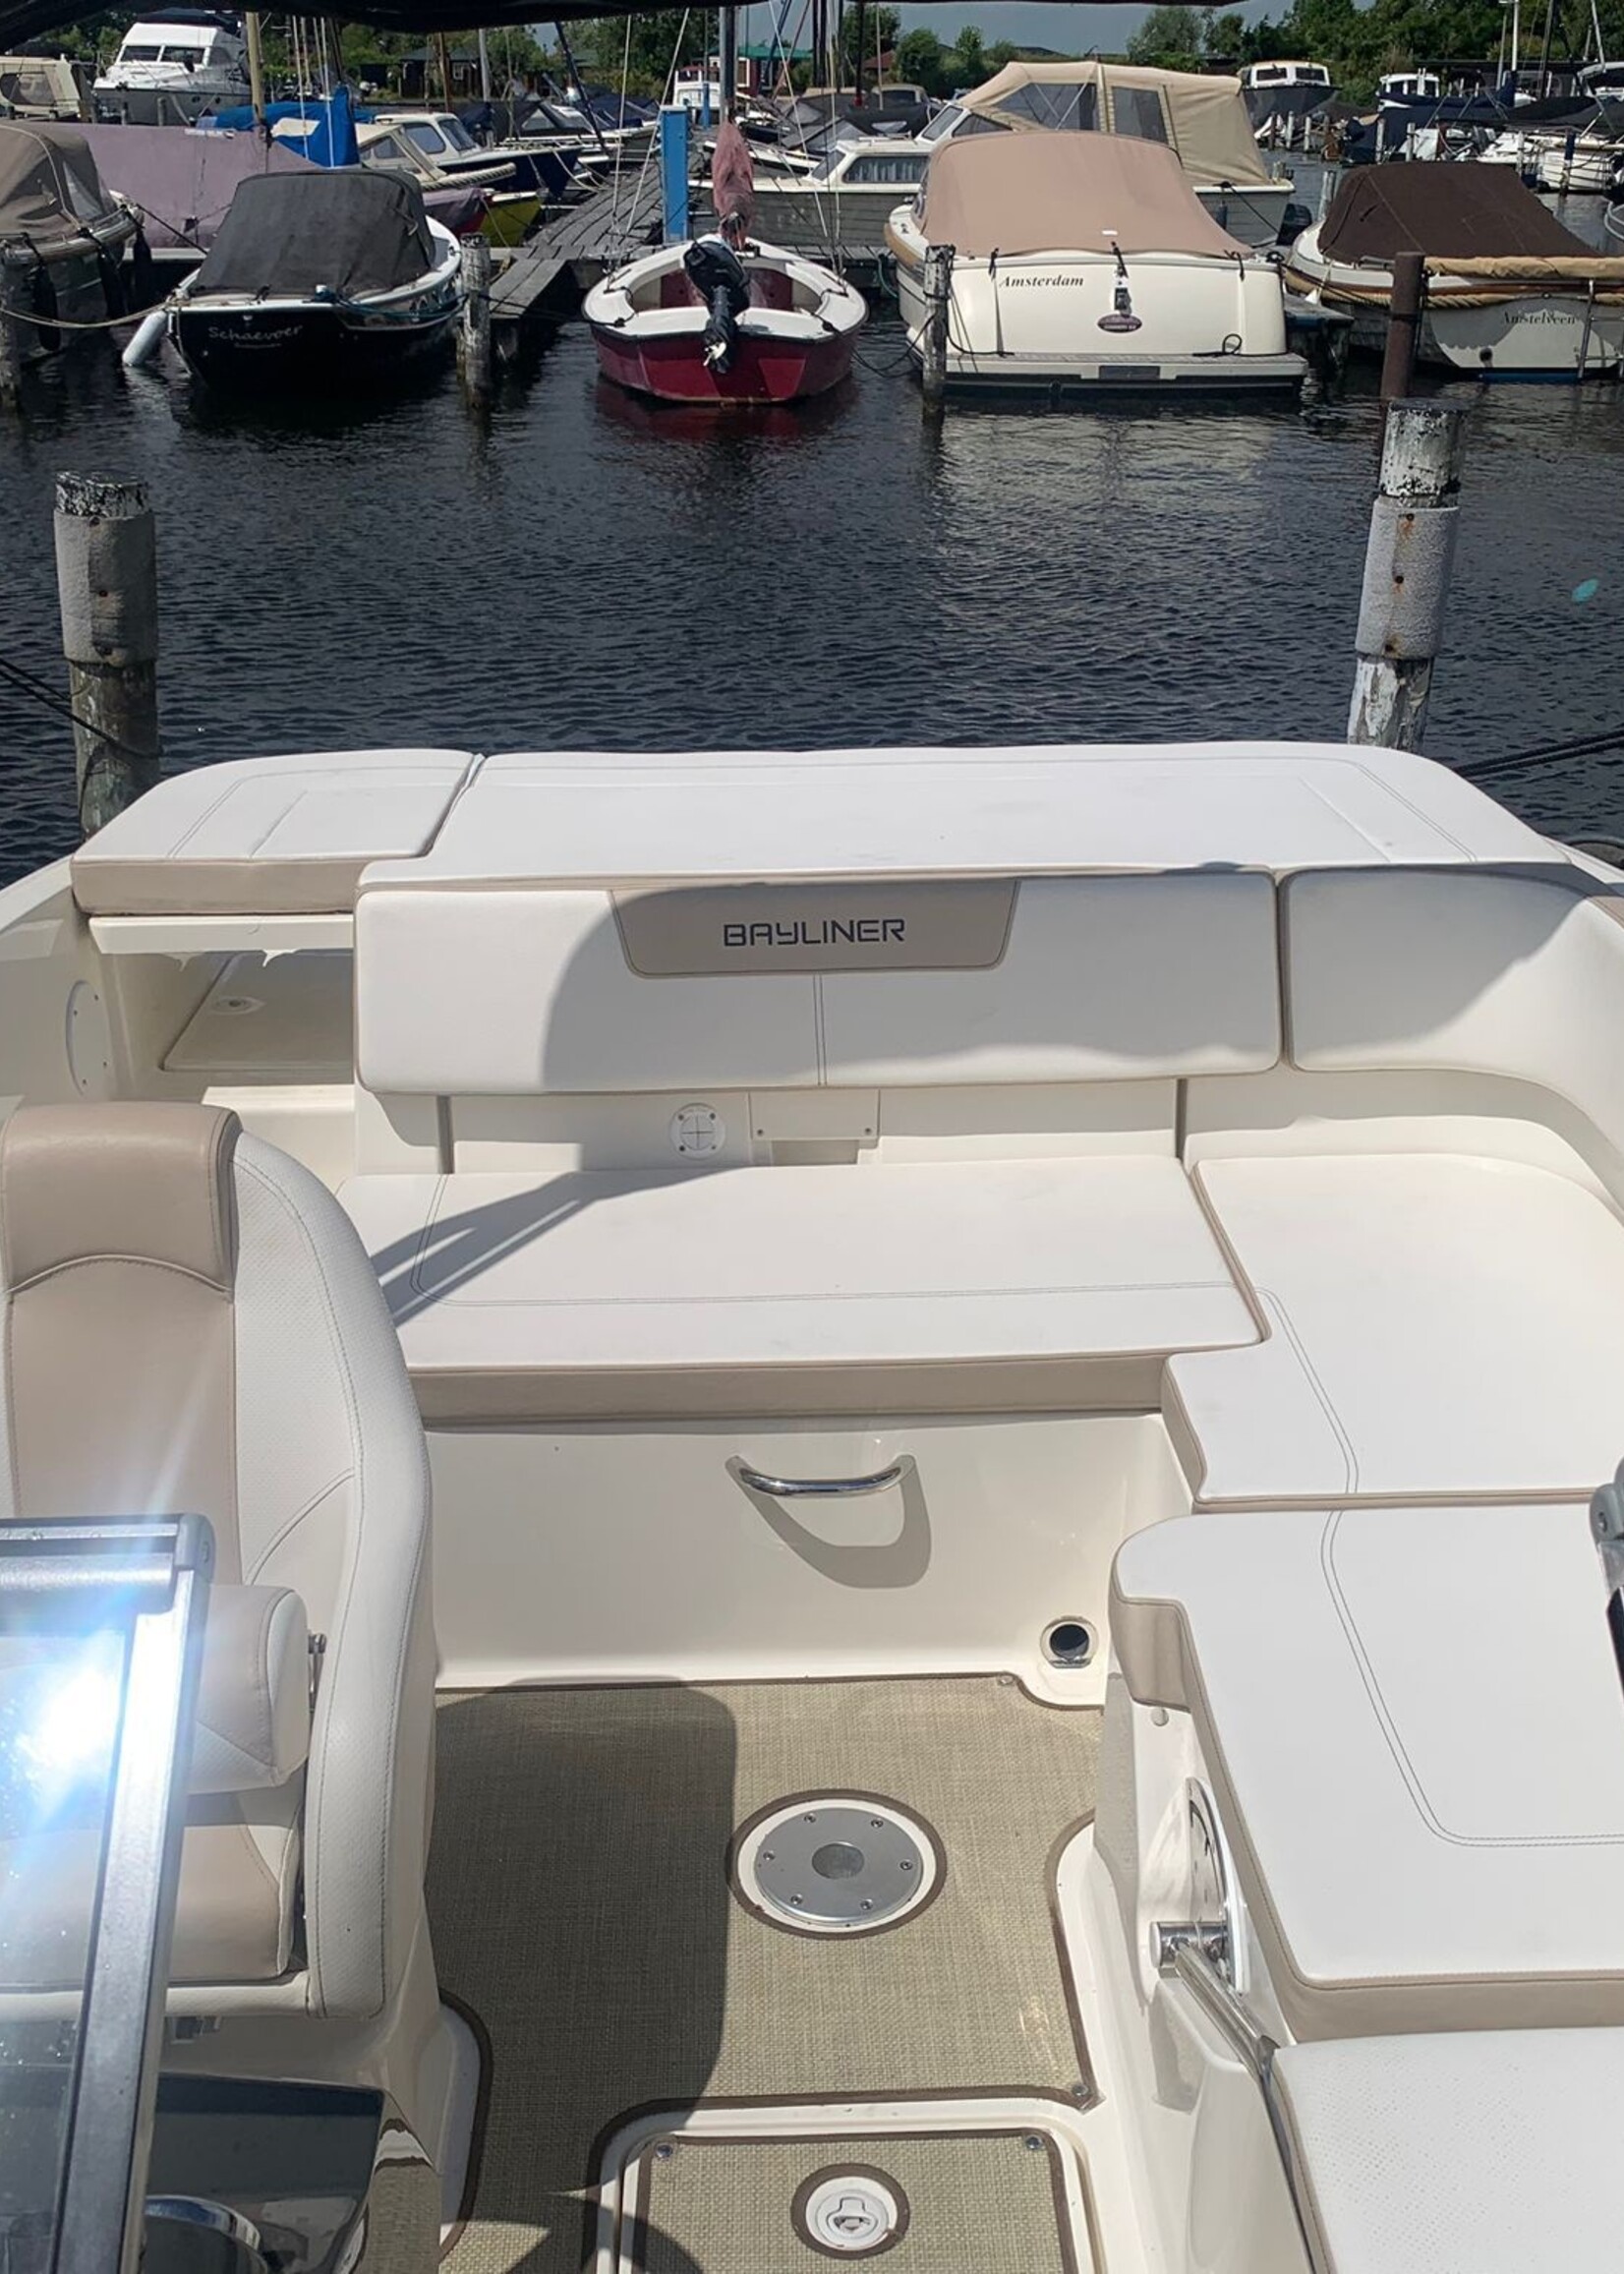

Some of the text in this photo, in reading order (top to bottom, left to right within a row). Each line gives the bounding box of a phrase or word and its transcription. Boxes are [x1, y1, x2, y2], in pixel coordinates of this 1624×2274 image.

[999, 274, 1084, 287] Amsterdam
[1502, 311, 1576, 324] Amstelveen
[723, 918, 905, 947] BAYLINER
